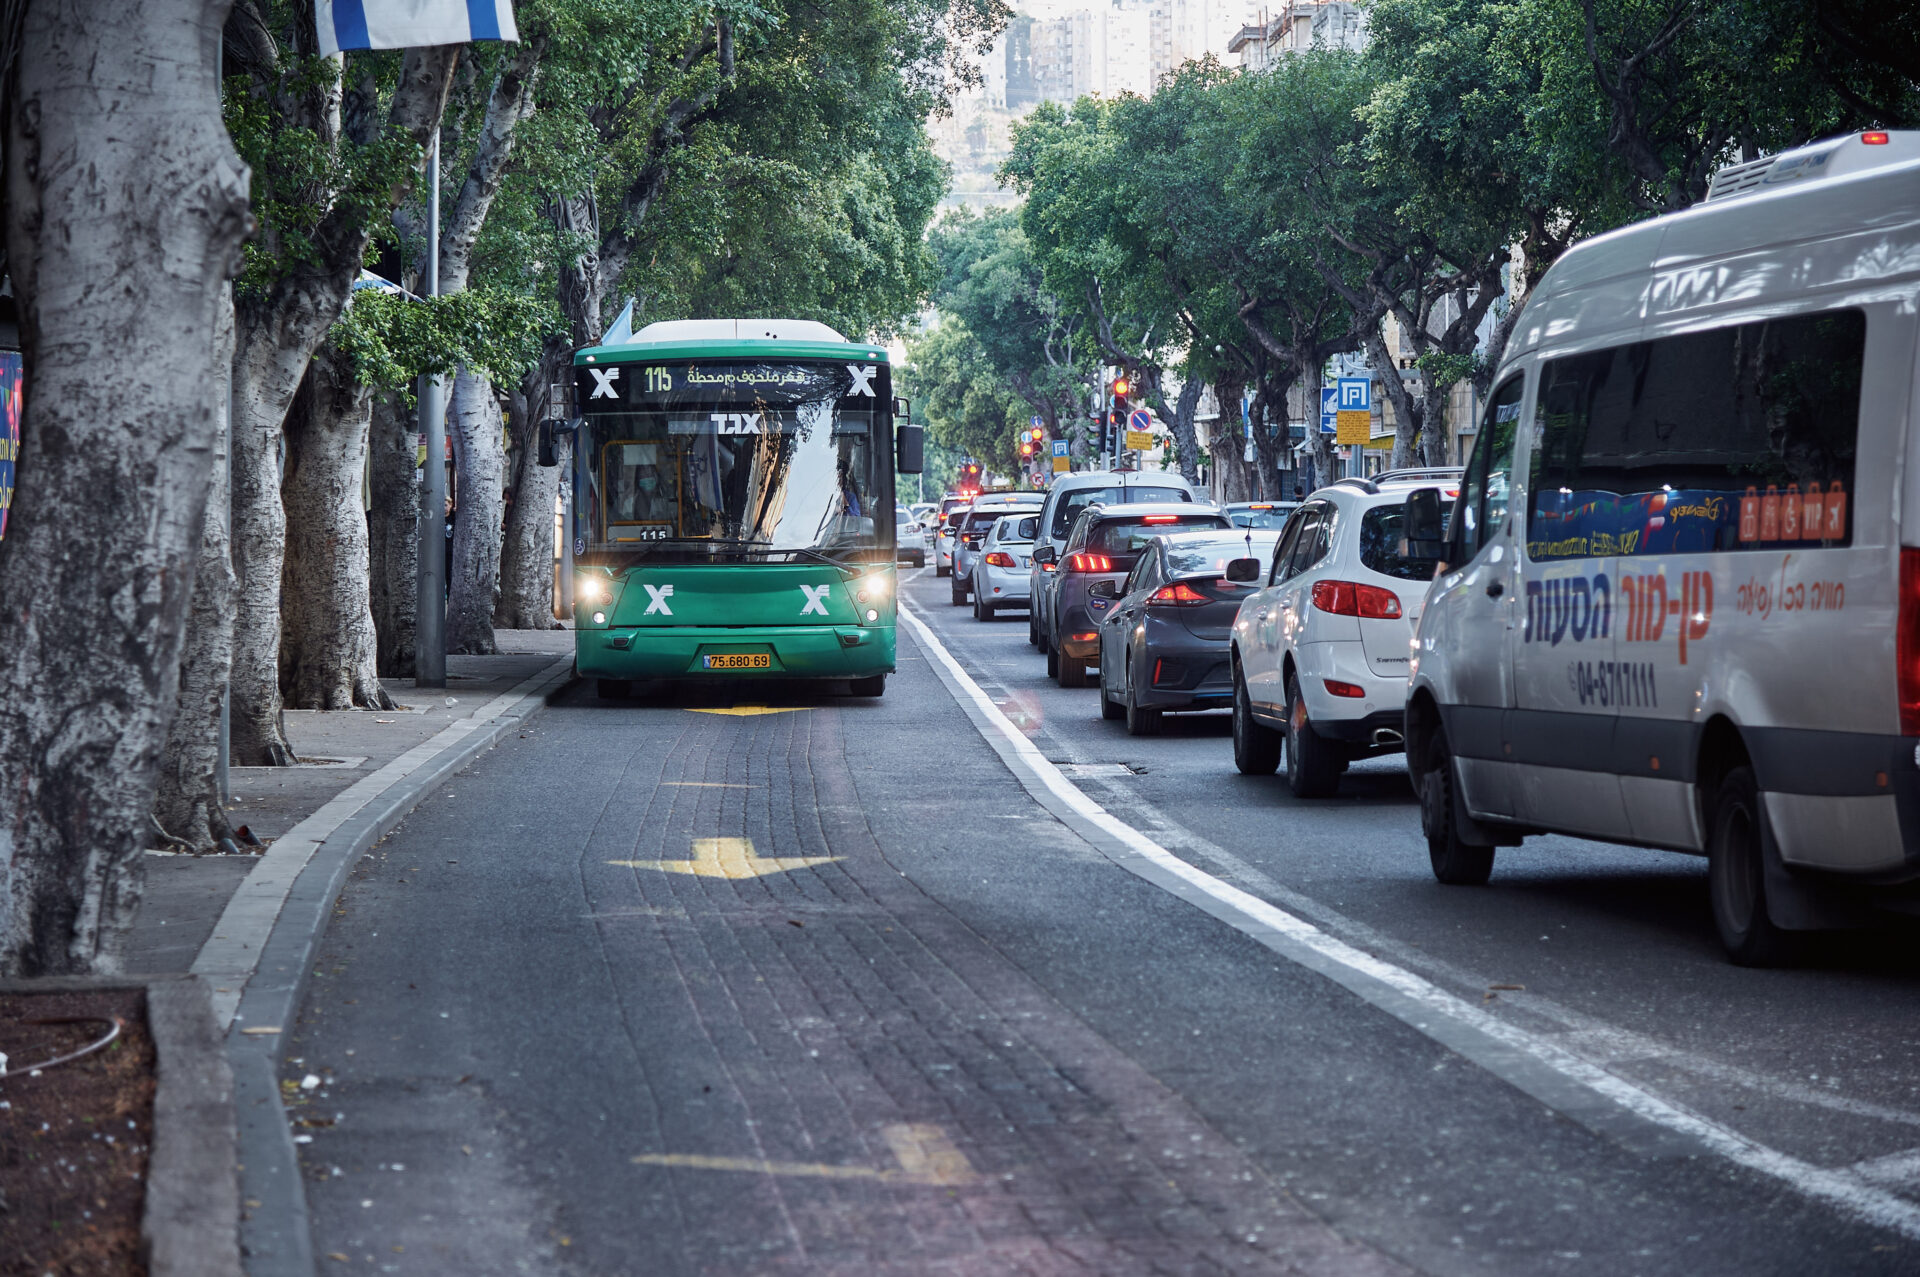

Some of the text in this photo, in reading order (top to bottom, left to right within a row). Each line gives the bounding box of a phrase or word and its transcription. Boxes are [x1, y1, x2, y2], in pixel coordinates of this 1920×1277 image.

[645, 367, 672, 392] 115
[1804, 503, 1823, 530] VIP
[641, 530, 666, 540] 115
[1524, 573, 1611, 648] הסעות
[1577, 660, 1658, 708] 04-8717111
